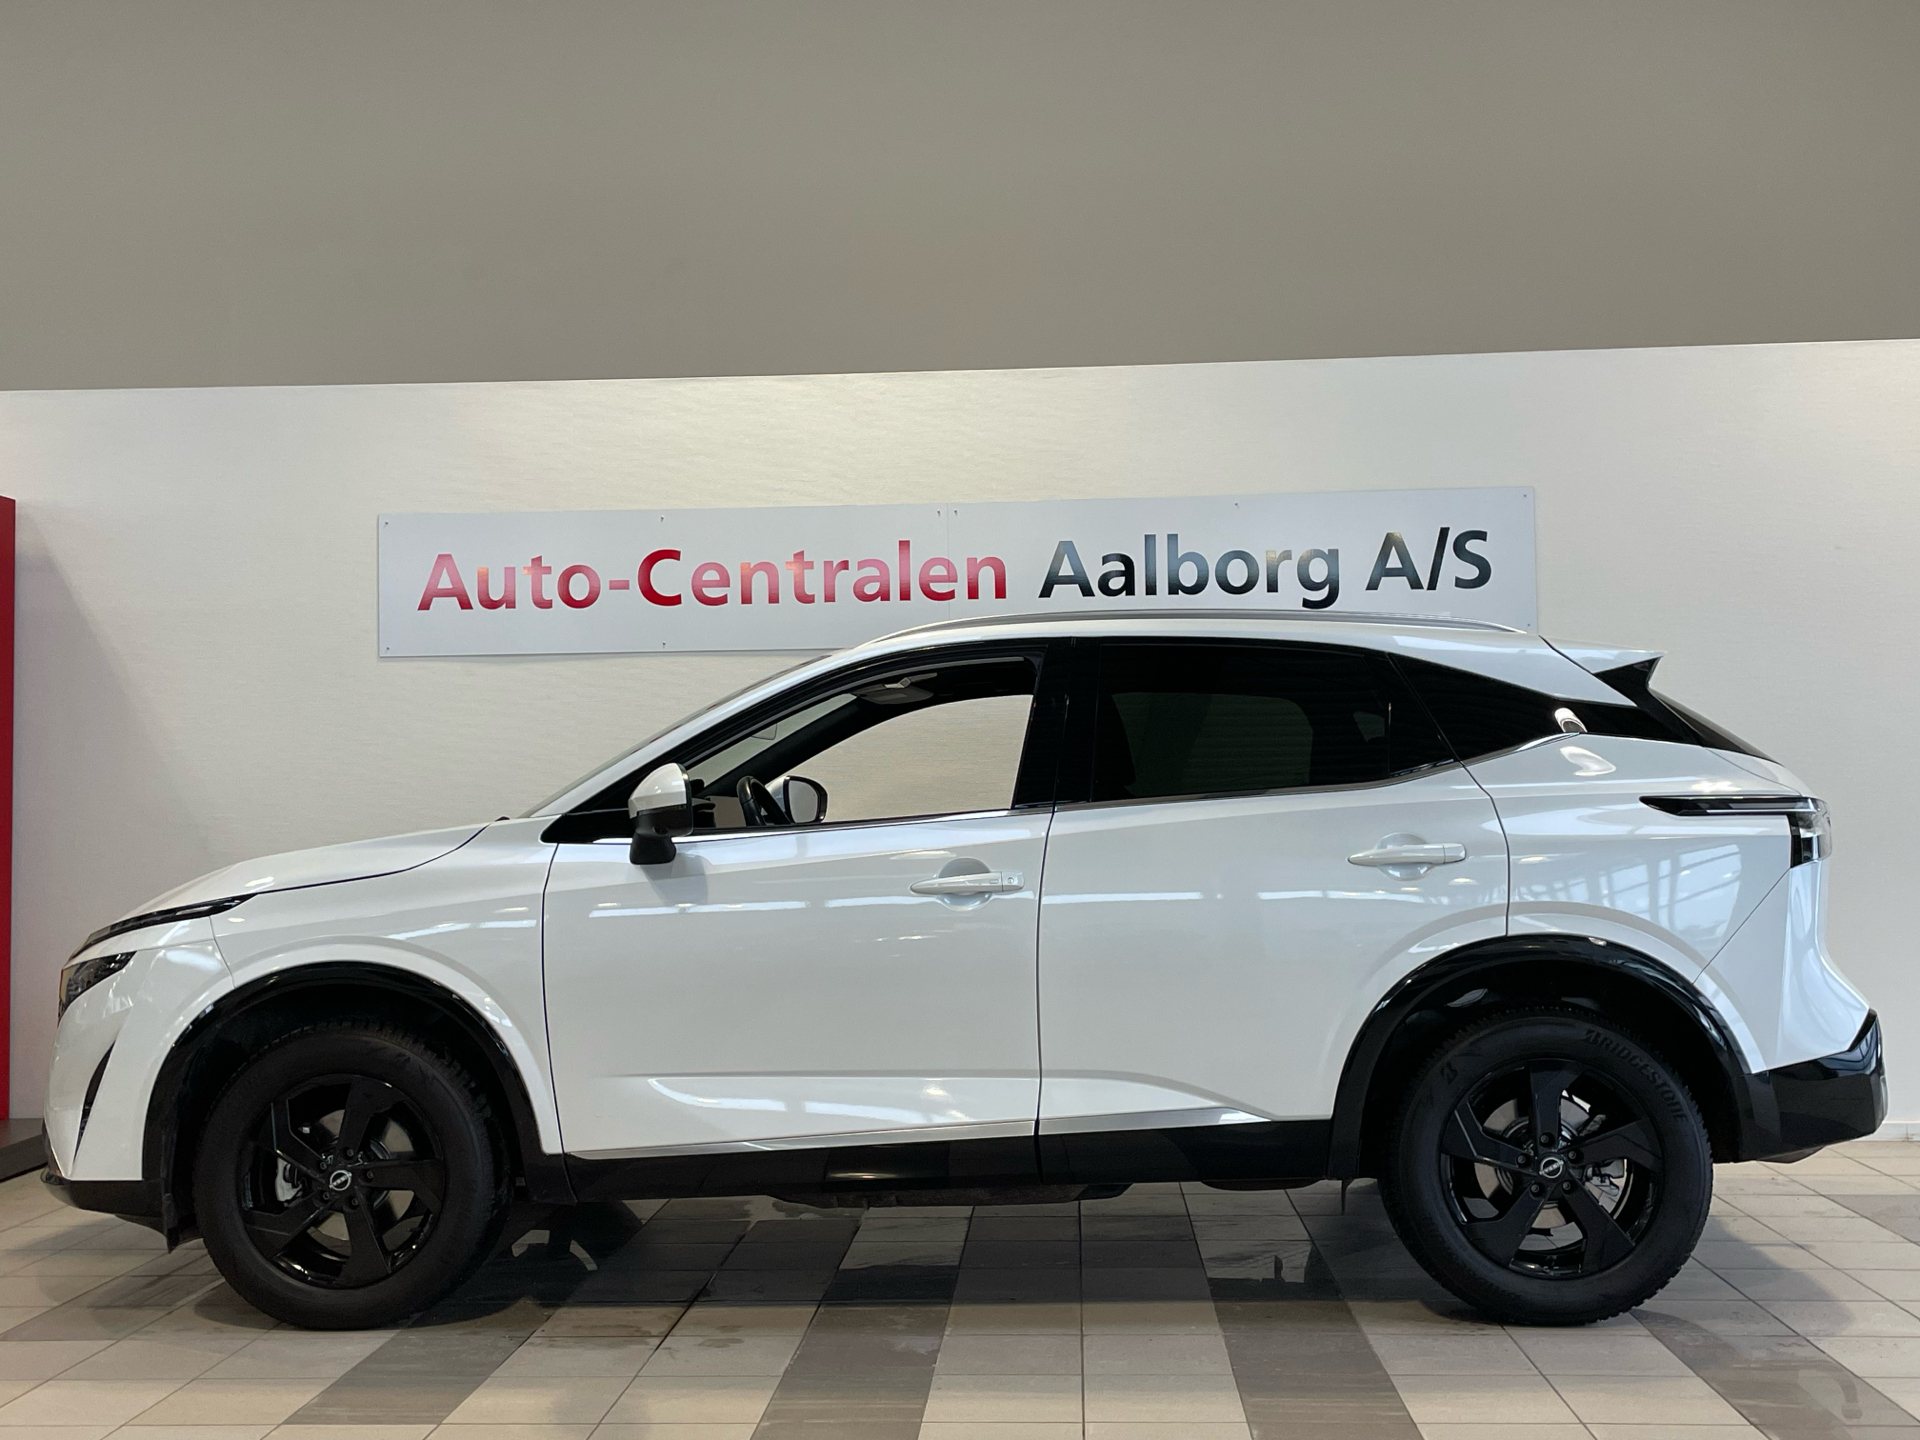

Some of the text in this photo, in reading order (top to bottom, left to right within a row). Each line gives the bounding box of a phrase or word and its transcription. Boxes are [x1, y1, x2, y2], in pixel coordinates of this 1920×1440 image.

[417, 526, 1493, 611] Auto-Centralen Aalborg A/S
[1583, 1028, 1688, 1123] BRIDGESTONE
